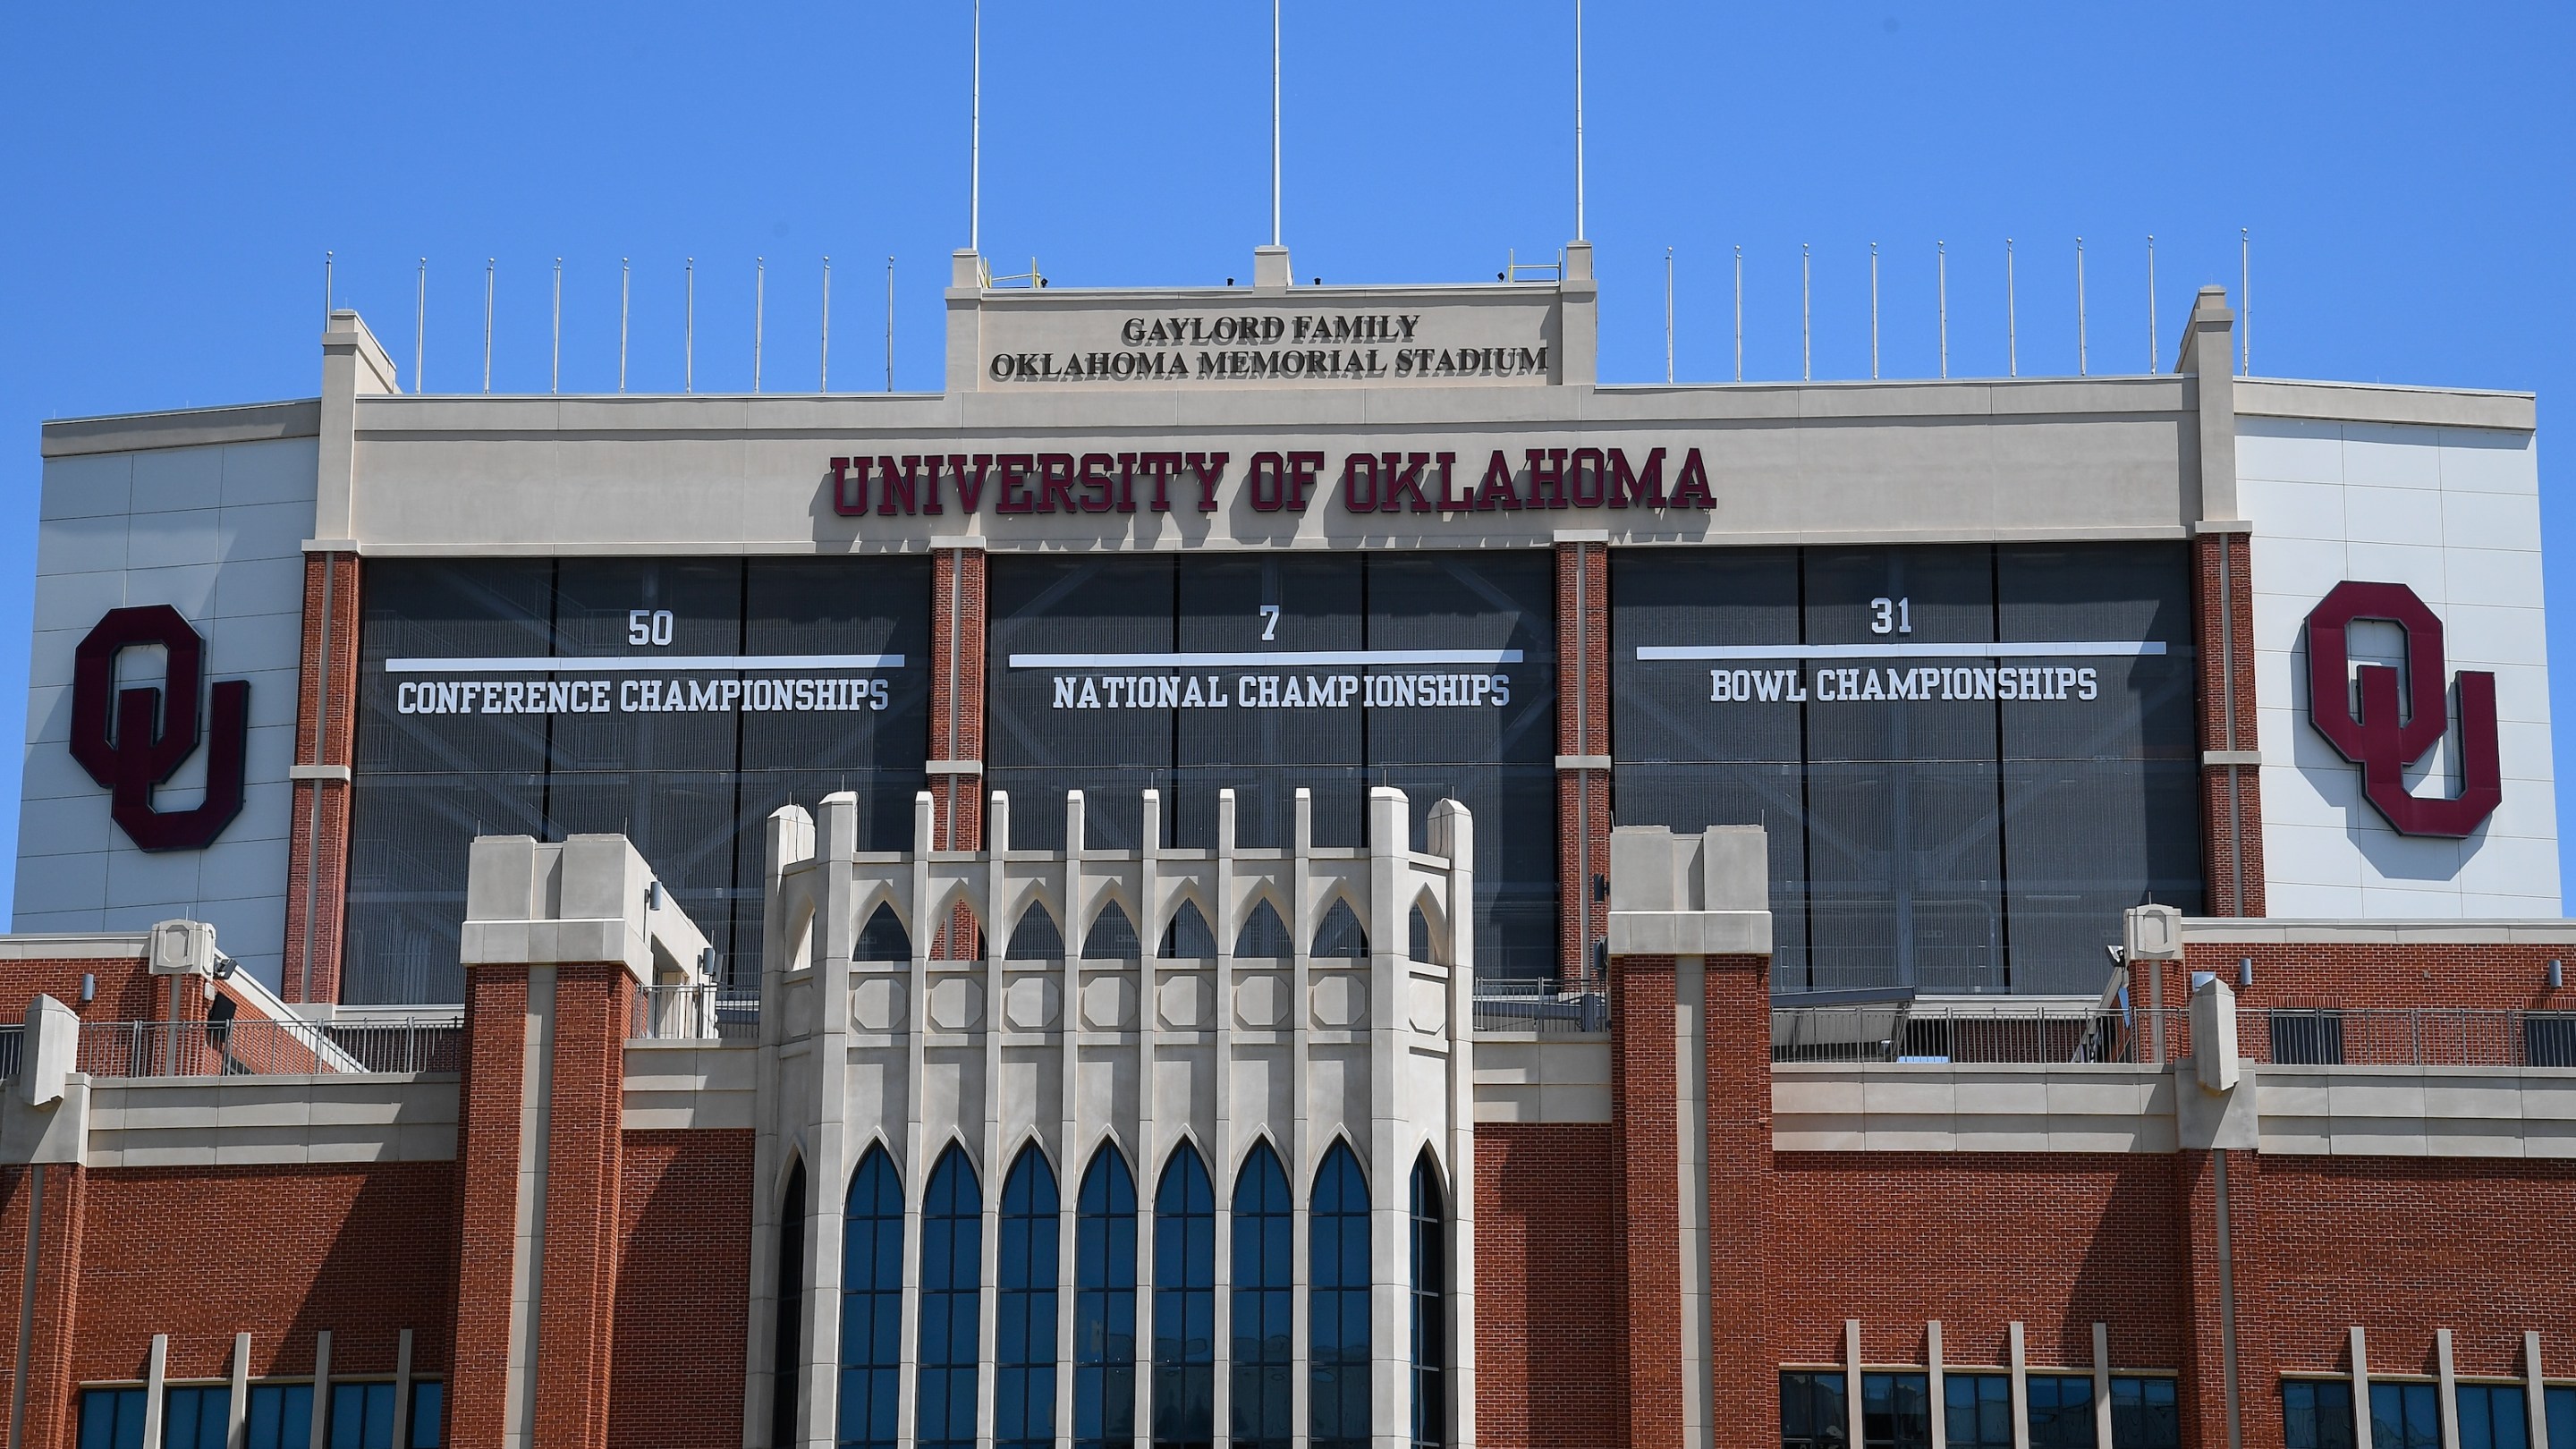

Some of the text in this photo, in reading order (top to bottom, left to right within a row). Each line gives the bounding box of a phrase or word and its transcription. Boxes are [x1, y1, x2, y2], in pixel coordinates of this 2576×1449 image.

[1123, 314, 1420, 342] GAYLORD FAMILY
[992, 346, 1549, 377] OKLAHOMA MEMORIAL STADIUM
[830, 447, 1716, 516] UNIVERSITY OF OKLAHOMA
[628, 609, 674, 646] 50
[1259, 605, 1280, 641] 7
[1870, 597, 1912, 633] 31
[397, 678, 889, 715] CONFERENCE CHAMPIONSHIPS
[1053, 673, 1510, 708] NATIONAL CHAMPIONSHIPS
[1710, 666, 2098, 702] BOWL CHAMPIONSHIPS
[2304, 580, 2503, 840] OU
[69, 604, 250, 853] OU
